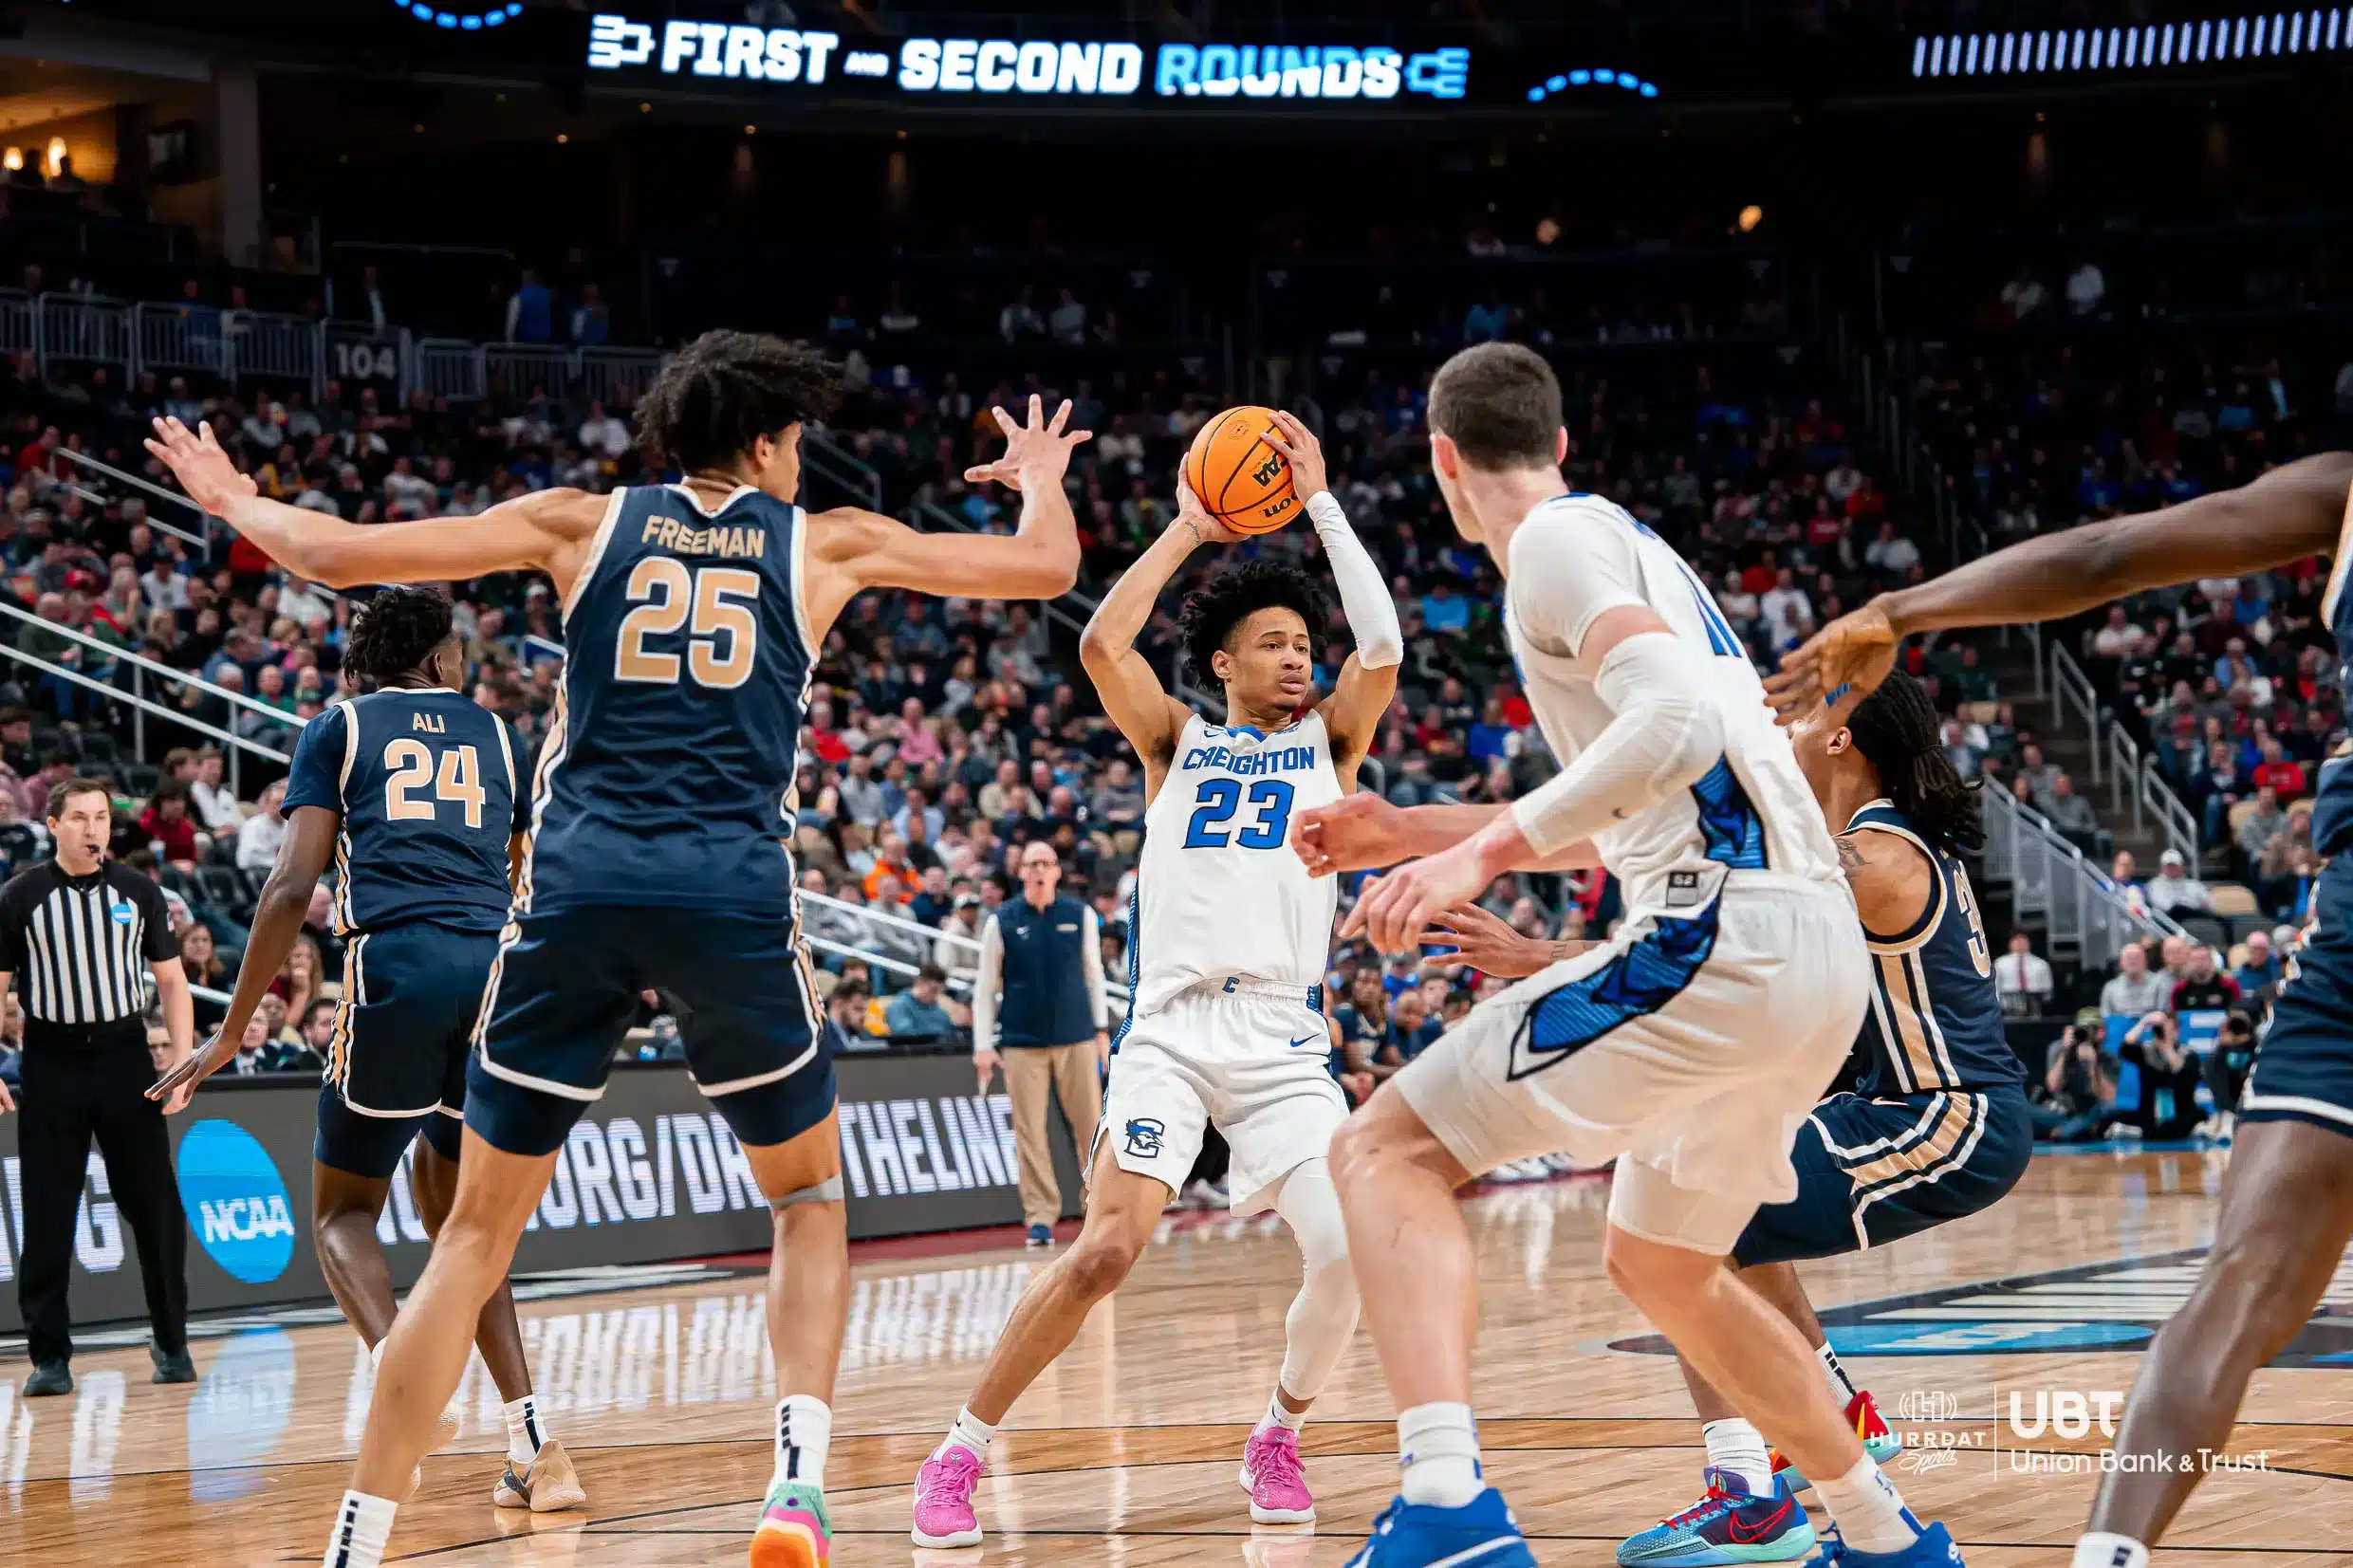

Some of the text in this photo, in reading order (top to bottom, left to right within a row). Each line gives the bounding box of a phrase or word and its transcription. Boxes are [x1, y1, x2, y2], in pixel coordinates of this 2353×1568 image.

[661, 20, 839, 83] FIRST
[899, 39, 1143, 92] SECOND
[1156, 44, 1402, 98] ROUNDS
[335, 343, 395, 379] 104
[641, 515, 765, 558] FREEMAN
[614, 556, 760, 689] 25
[413, 712, 446, 733] ALI
[384, 739, 486, 828] 24
[1182, 746, 1315, 775] CREIGHTON
[1181, 778, 1295, 850] 23
[199, 1194, 295, 1243] NCAA
